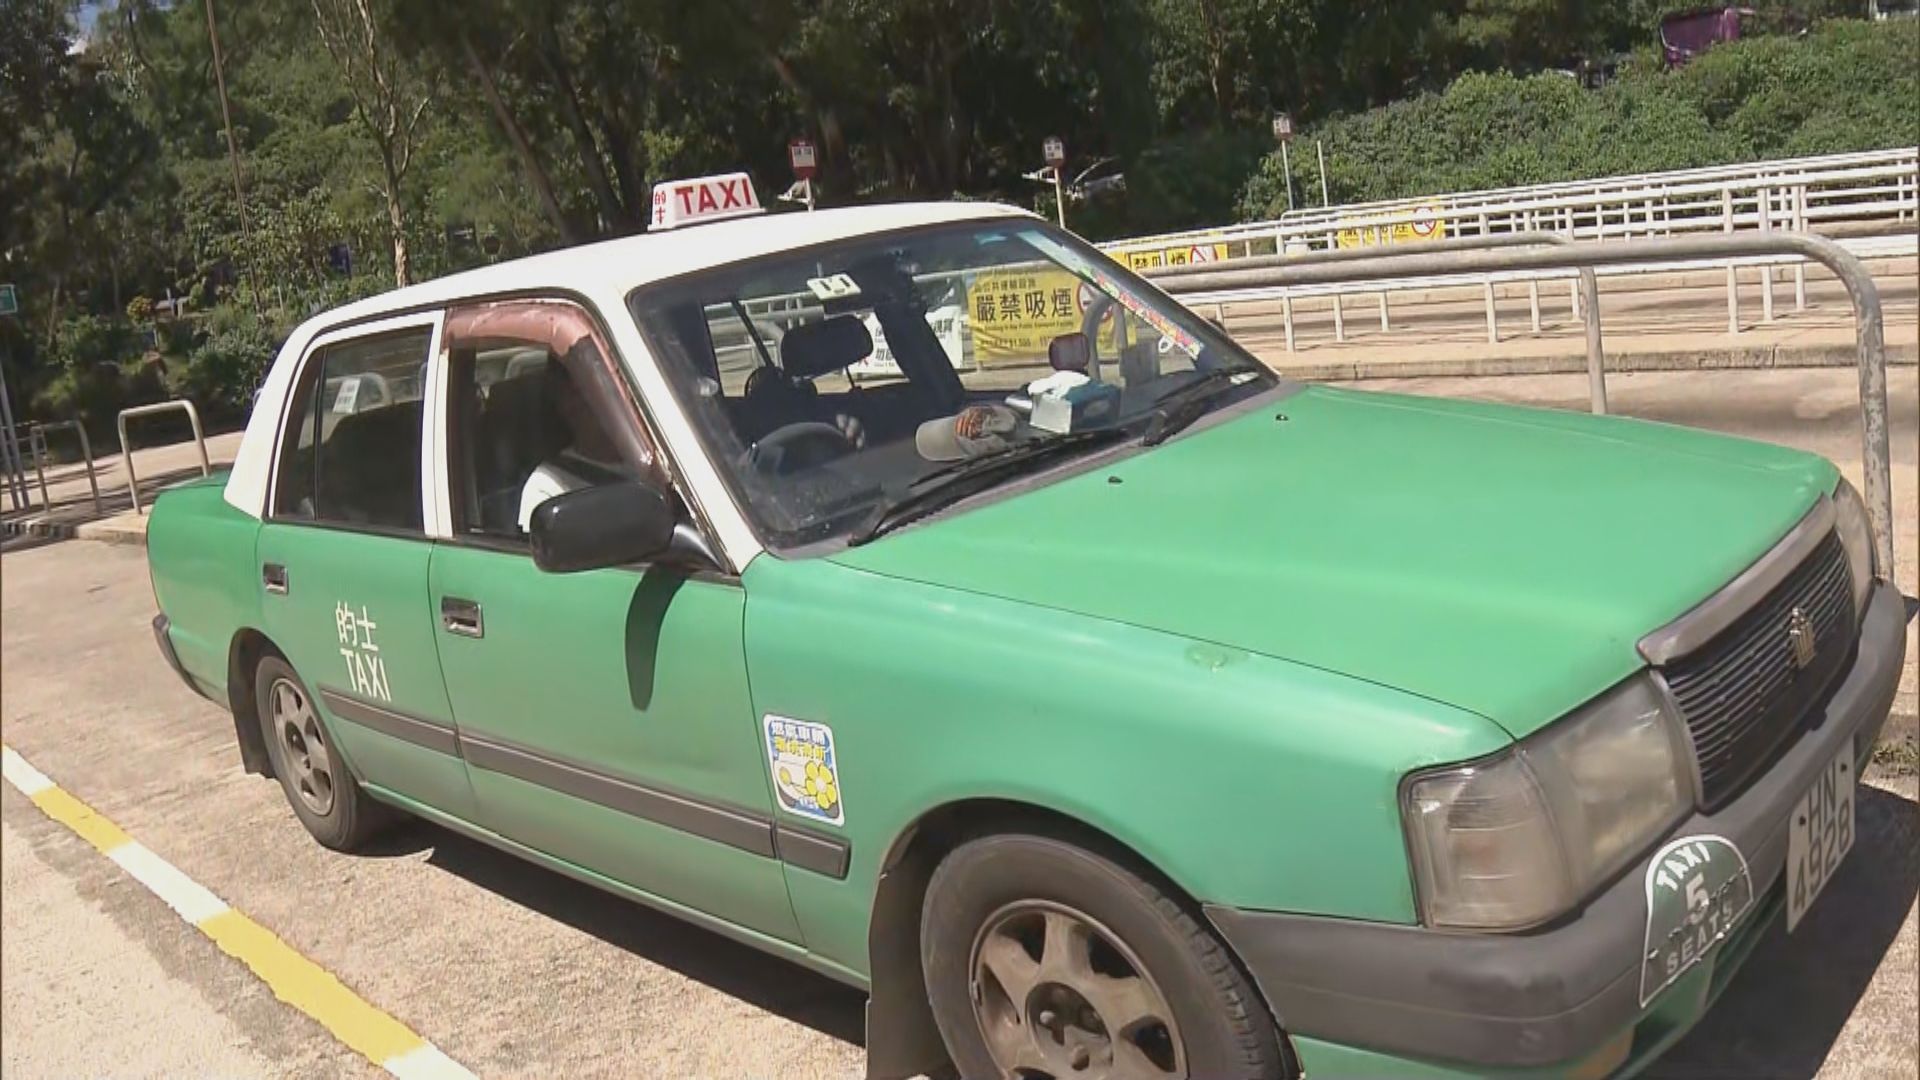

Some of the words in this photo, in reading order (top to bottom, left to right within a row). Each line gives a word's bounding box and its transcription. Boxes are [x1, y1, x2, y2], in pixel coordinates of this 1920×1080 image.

[654, 190, 667, 225] 的士
[675, 178, 752, 215] TAXI
[976, 287, 1074, 323] 嚴禁吸煙
[335, 600, 379, 652] 的士
[340, 647, 392, 702] TAXI
[1808, 758, 1837, 845] HN
[1656, 842, 1711, 892] TAXI
[1793, 797, 1851, 912] 4928
[1685, 872, 1710, 925] 5
[1666, 899, 1734, 976] SEATS
